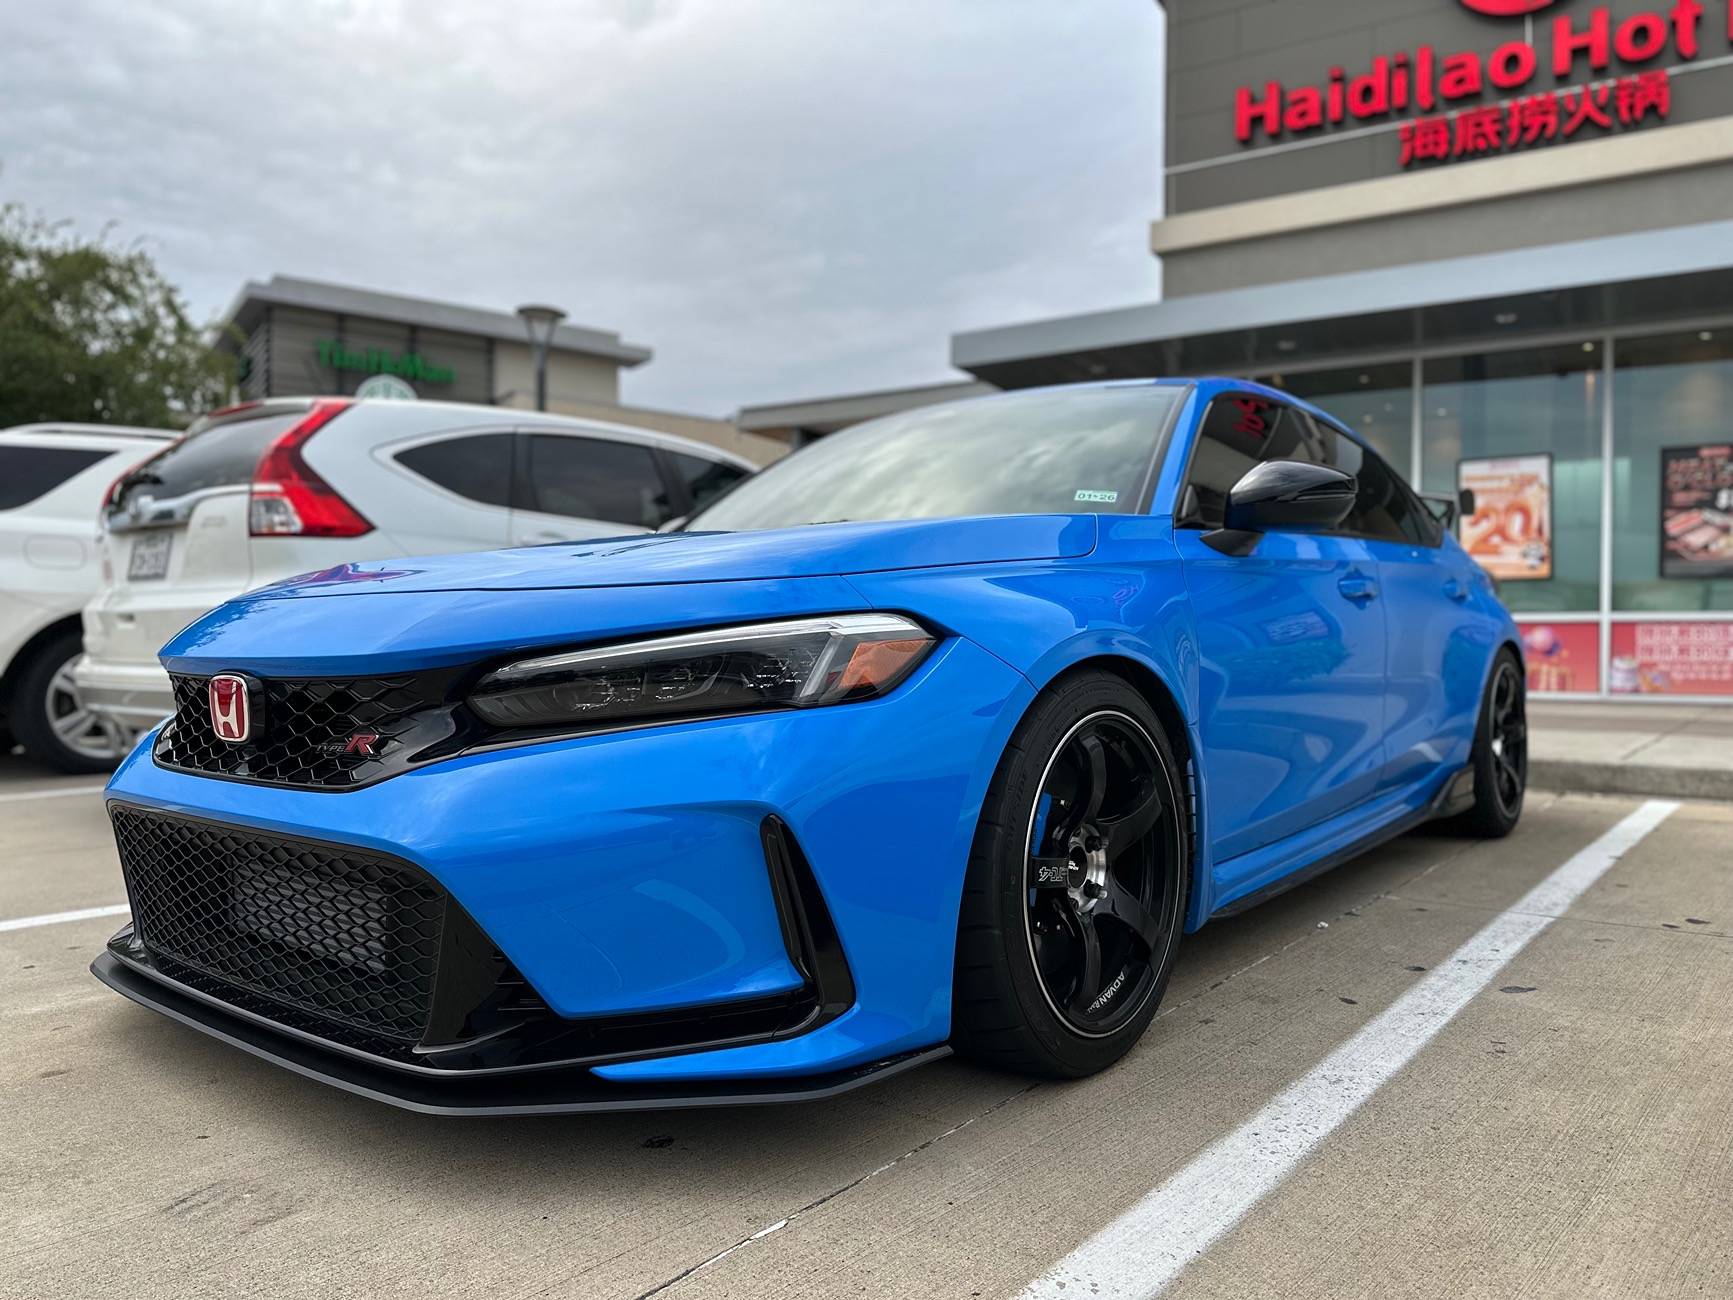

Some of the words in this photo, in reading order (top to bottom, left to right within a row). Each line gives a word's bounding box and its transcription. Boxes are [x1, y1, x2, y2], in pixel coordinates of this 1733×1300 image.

[1234, 40, 1537, 142] Haidilao
[1552, 0, 1702, 76] Hot
[1398, 68, 1671, 167] 海底捞火锅
[345, 732, 379, 755] R
[1097, 970, 1126, 1005] ADVAN
